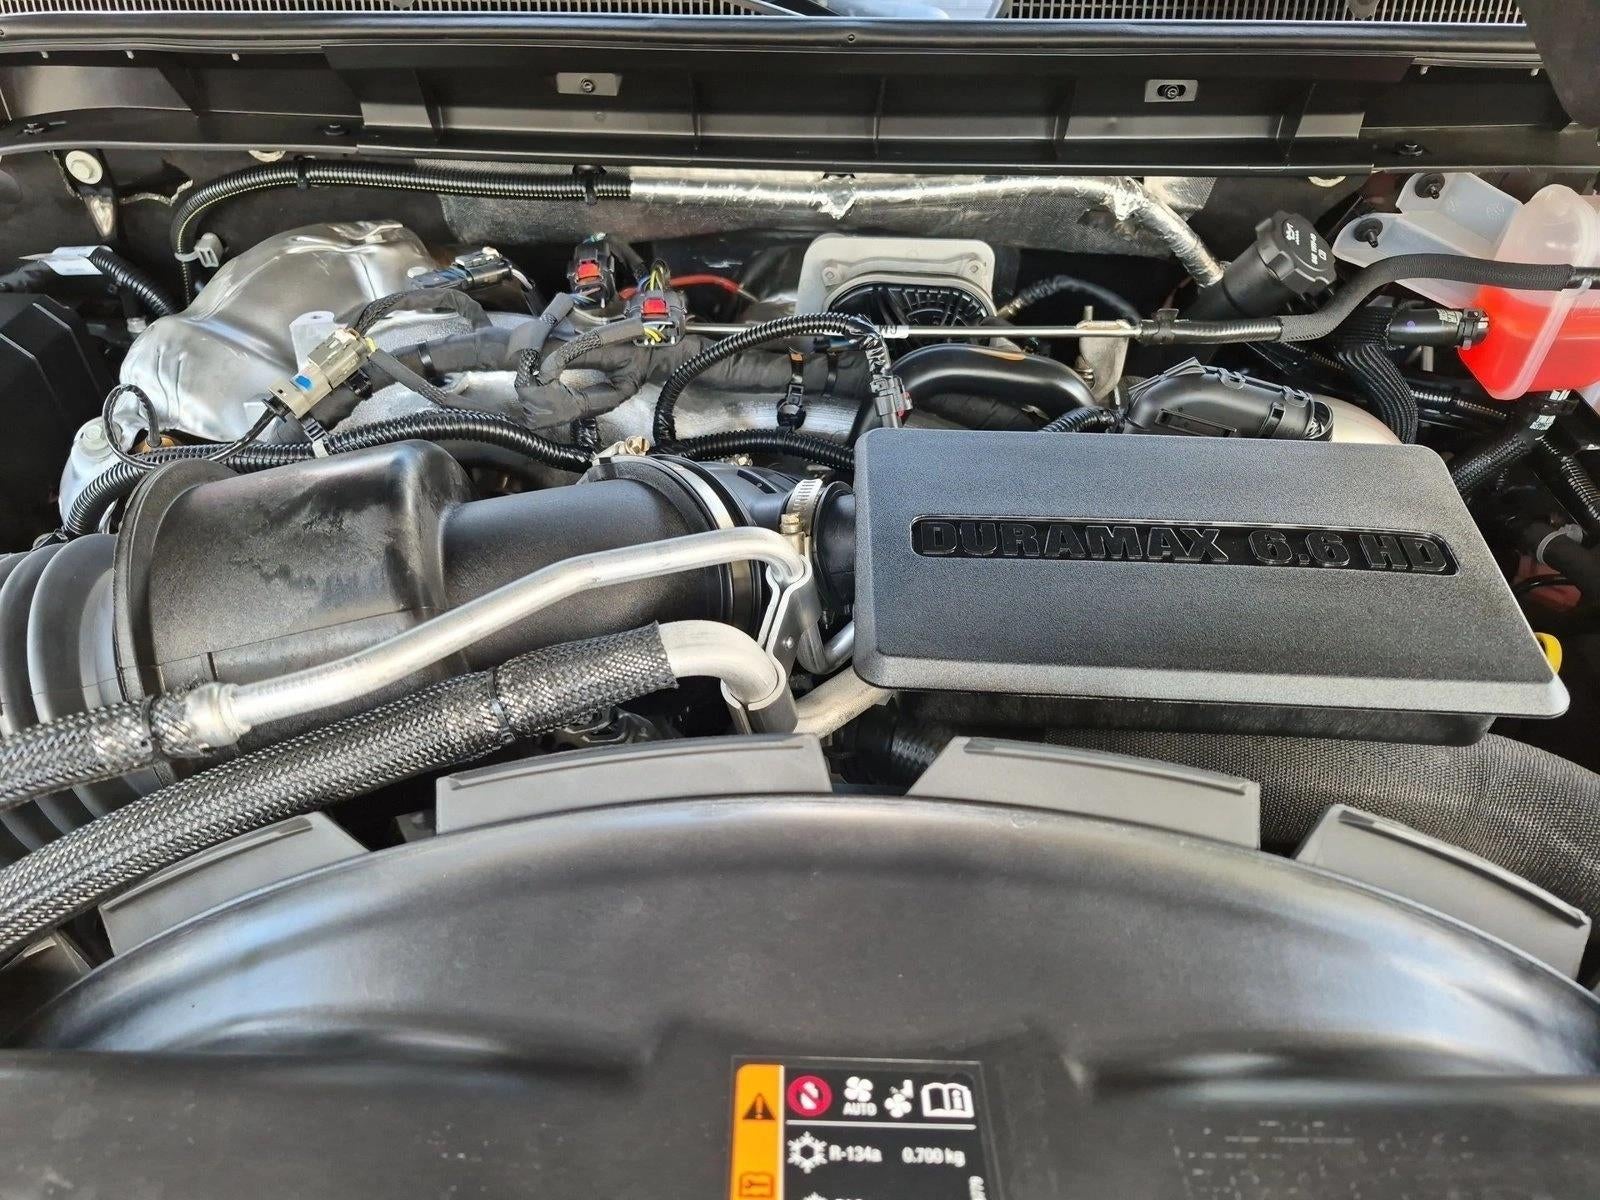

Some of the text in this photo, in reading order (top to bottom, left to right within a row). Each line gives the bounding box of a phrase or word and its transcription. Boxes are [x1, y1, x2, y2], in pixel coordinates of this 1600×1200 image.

[920, 521, 1447, 572] DURAMAX 6.6 HD
[842, 1102, 877, 1116] AUTO
[828, 1144, 966, 1168] R-134a 0.700 kg
